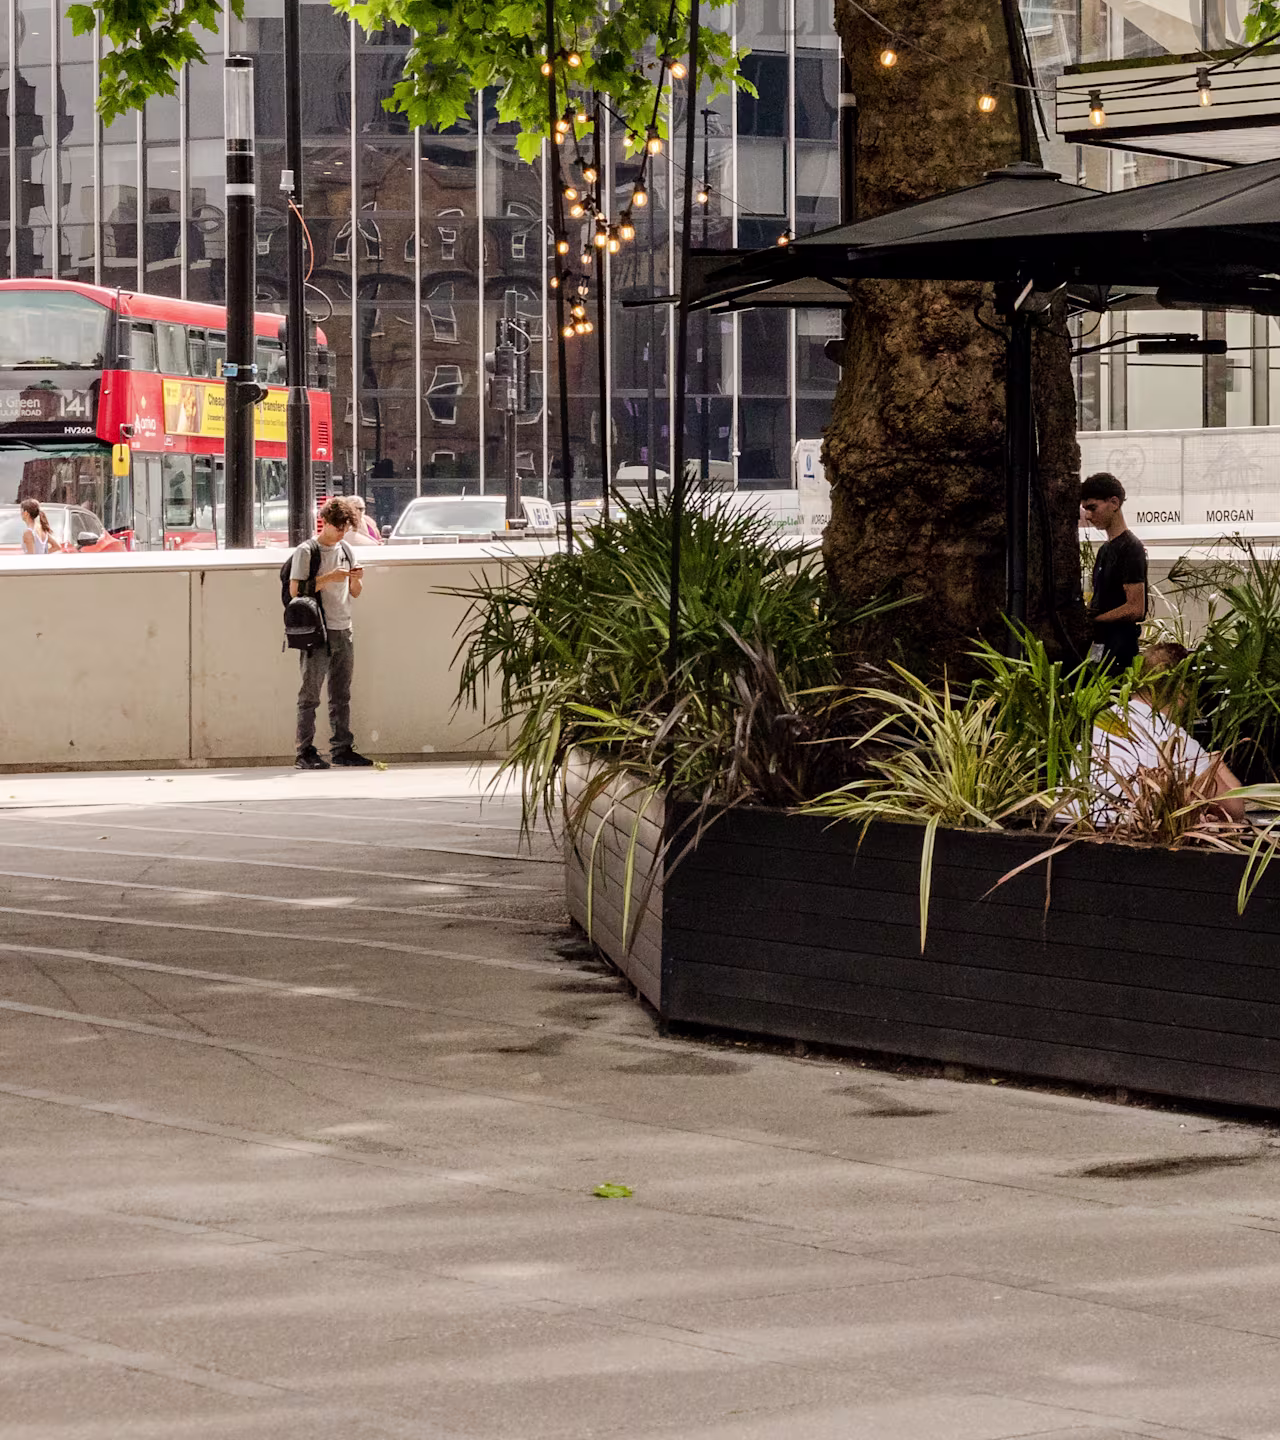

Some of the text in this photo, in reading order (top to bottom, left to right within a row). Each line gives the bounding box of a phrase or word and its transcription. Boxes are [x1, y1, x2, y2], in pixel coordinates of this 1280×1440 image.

[6, 397, 41, 408] Green
[60, 395, 90, 417] 141
[21, 409, 42, 417] ROAD
[64, 426, 92, 434] HV260
[1137, 510, 1181, 523] MORGAN
[1206, 509, 1254, 522] MORGAN
